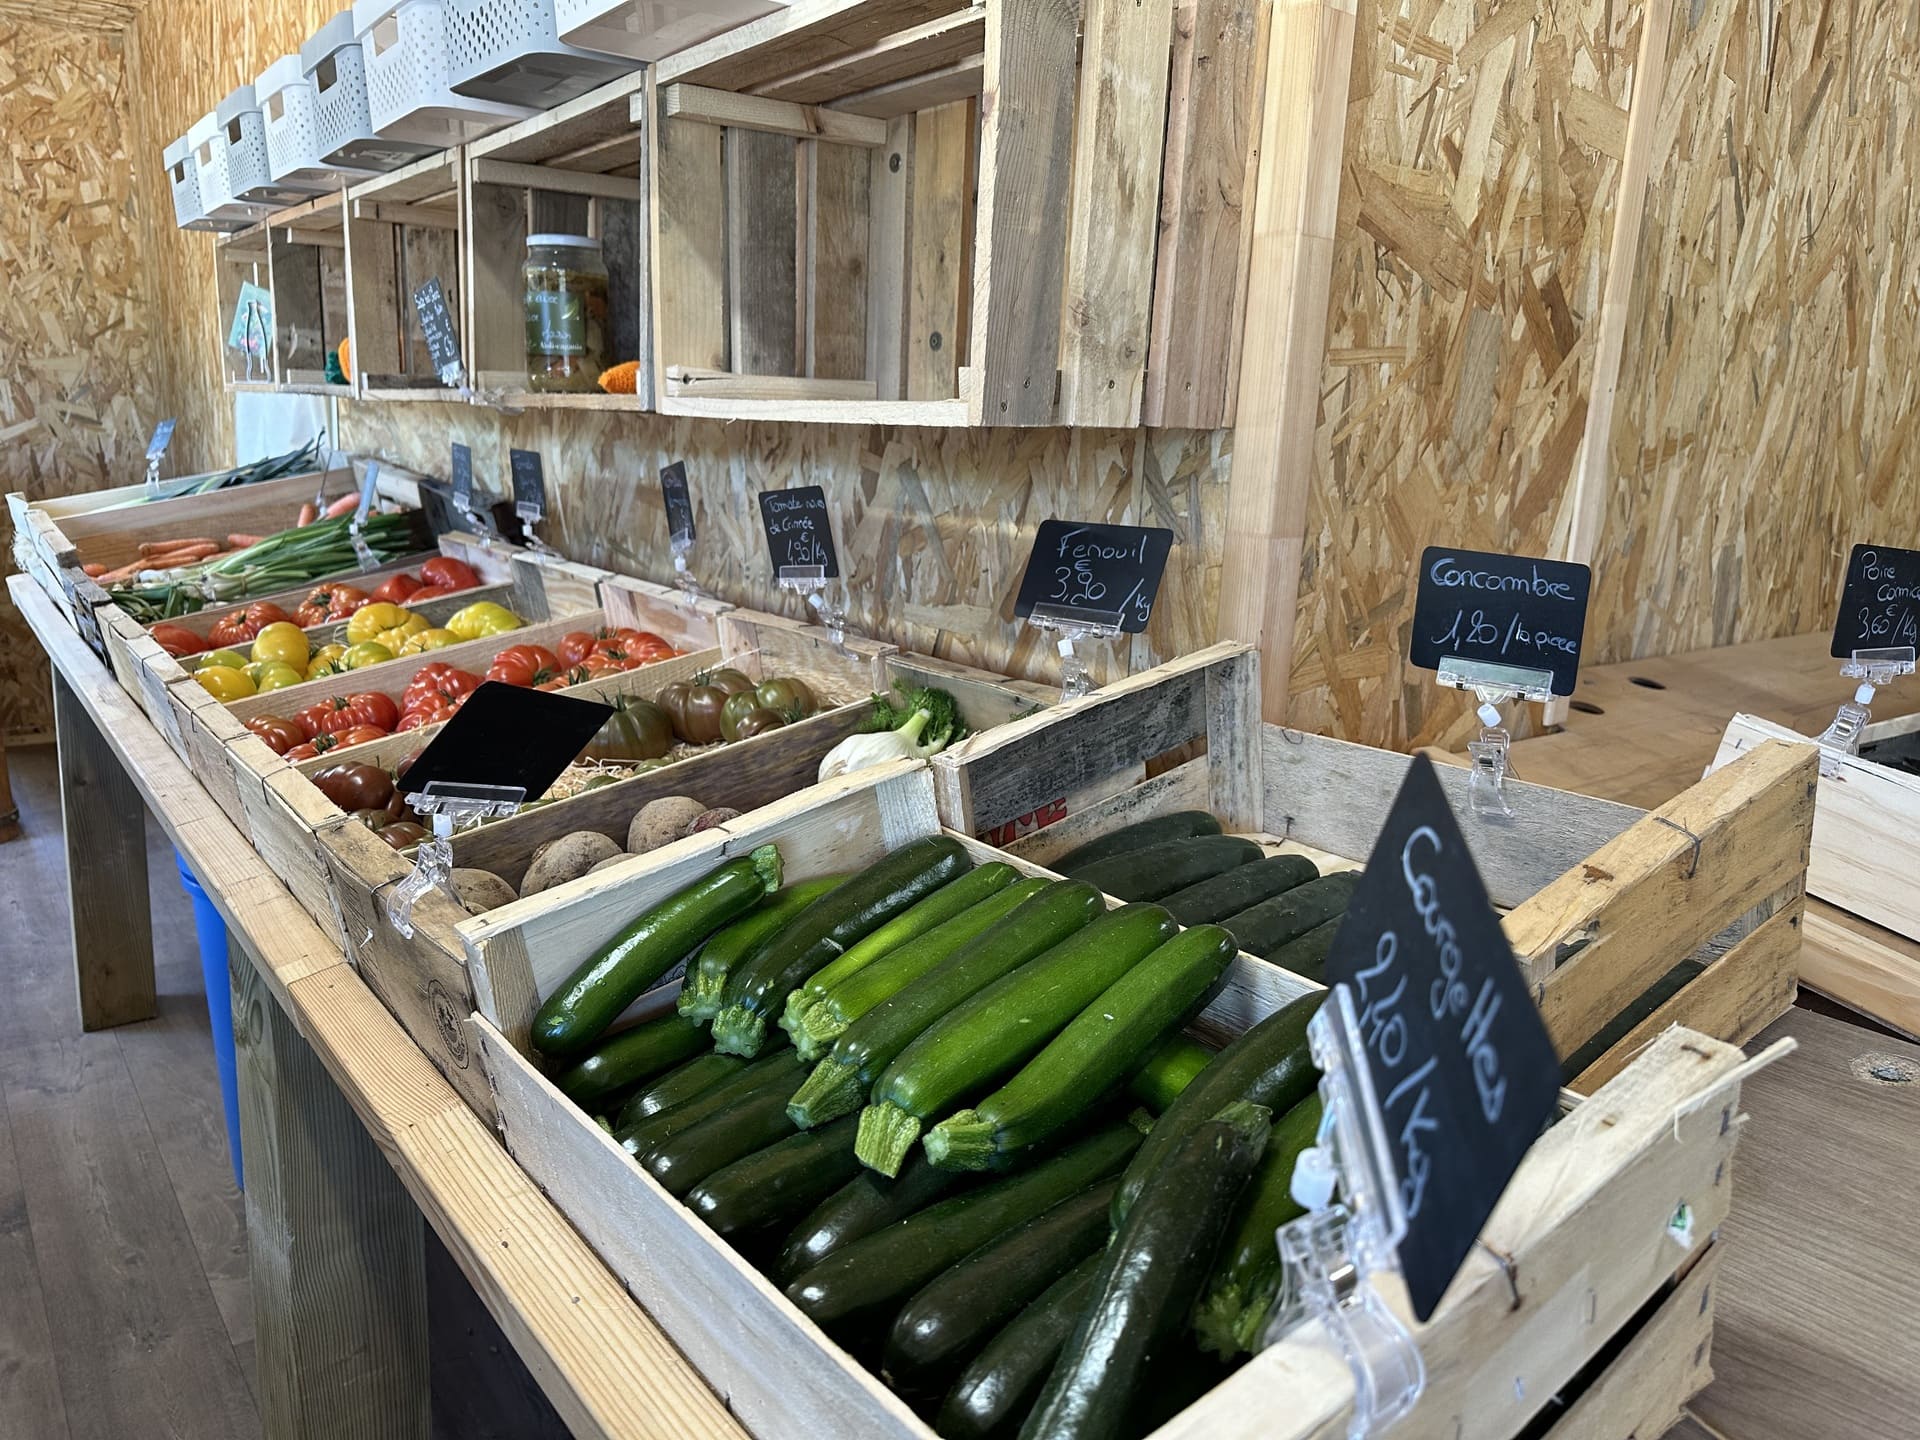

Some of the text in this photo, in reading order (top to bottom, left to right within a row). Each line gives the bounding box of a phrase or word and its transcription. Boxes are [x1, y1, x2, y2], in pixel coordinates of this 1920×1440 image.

[764, 494, 804, 513] Tomate
[769, 517, 781, 535] de
[800, 532, 809, 543] €
[1057, 527, 1147, 564] Fenouil
[1074, 559, 1092, 572] €
[1861, 551, 1896, 580] Poire
[1430, 558, 1576, 600] Concombre
[1886, 603, 1898, 617] €
[1402, 826, 1508, 1124] Courgettes
